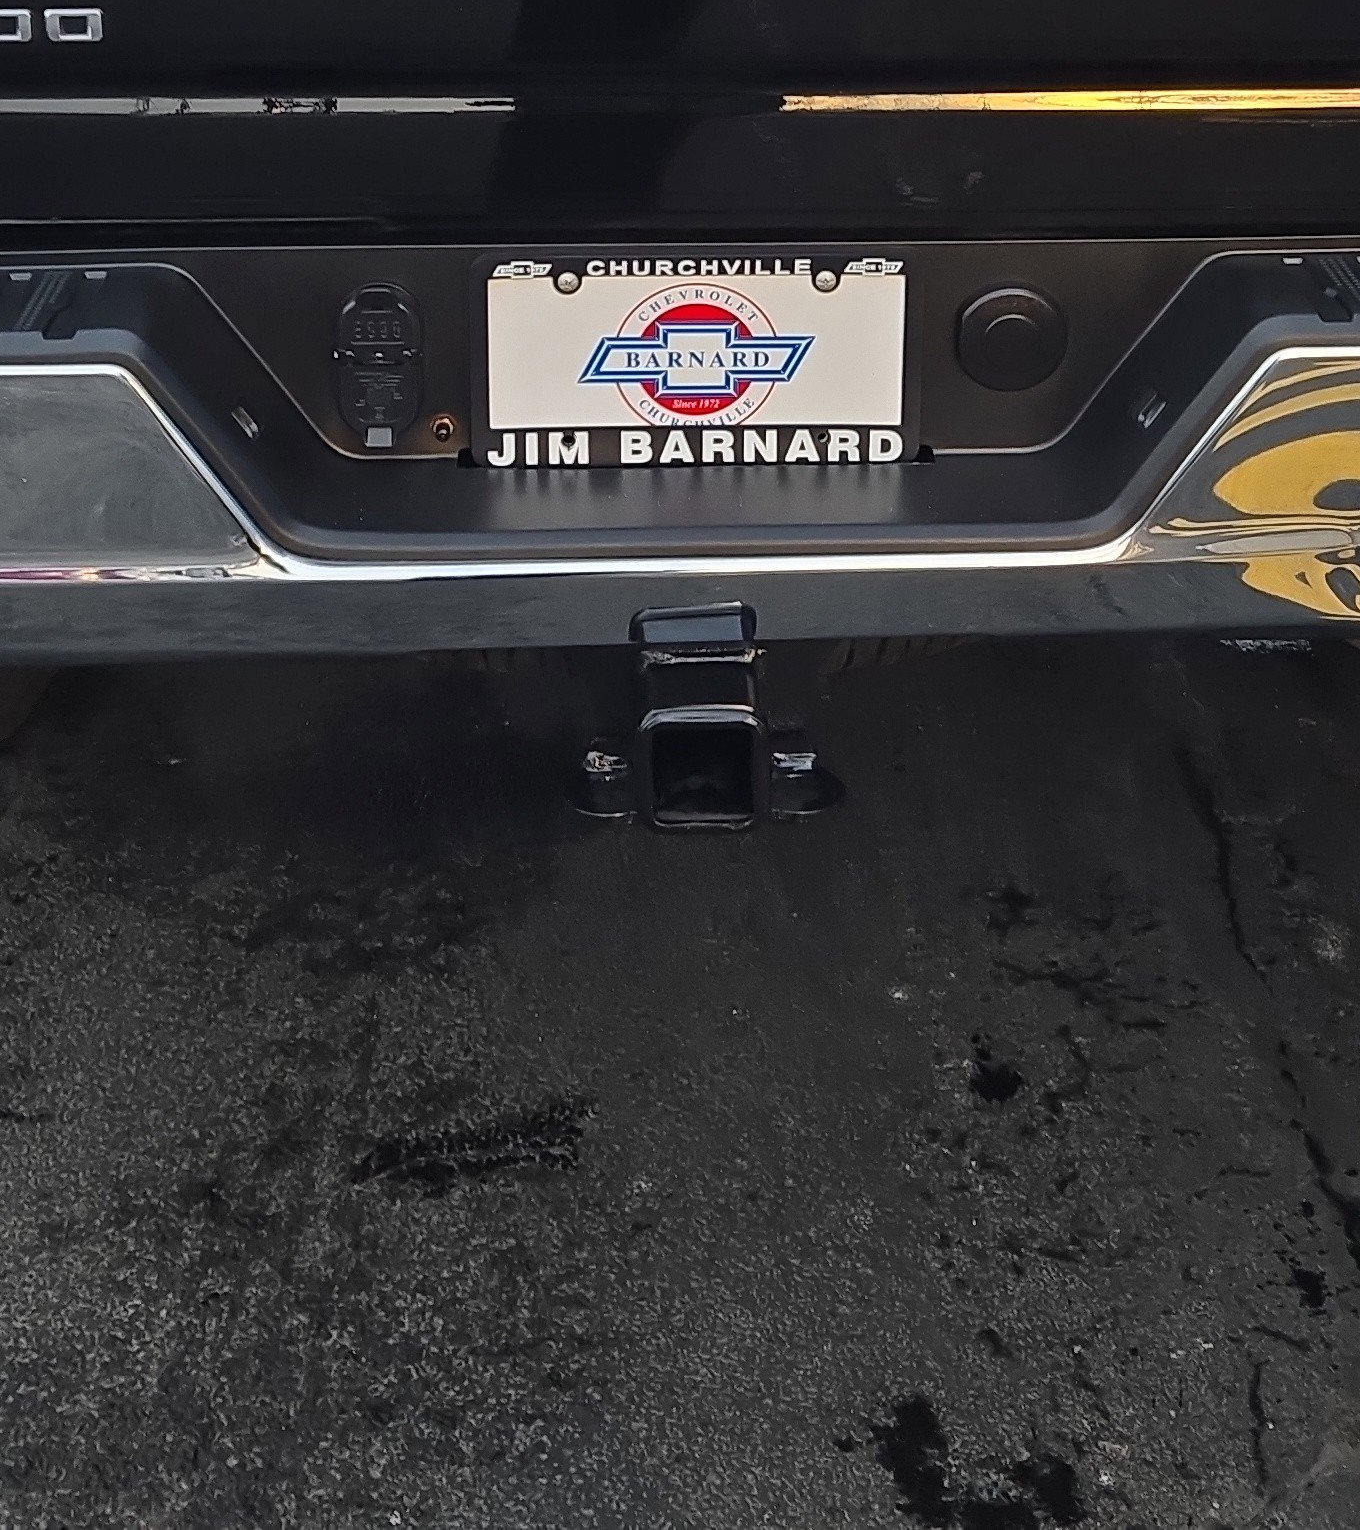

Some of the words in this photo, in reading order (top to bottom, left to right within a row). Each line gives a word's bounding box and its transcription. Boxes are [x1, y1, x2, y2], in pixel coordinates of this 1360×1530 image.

[586, 258, 813, 276] CHURCHVILLE
[638, 289, 759, 322] CHEVROLET
[626, 350, 770, 369] BARNARD
[672, 399, 697, 410] Since
[698, 399, 721, 410] 1972
[487, 431, 590, 468] JIM
[620, 428, 903, 466] BARNARD
